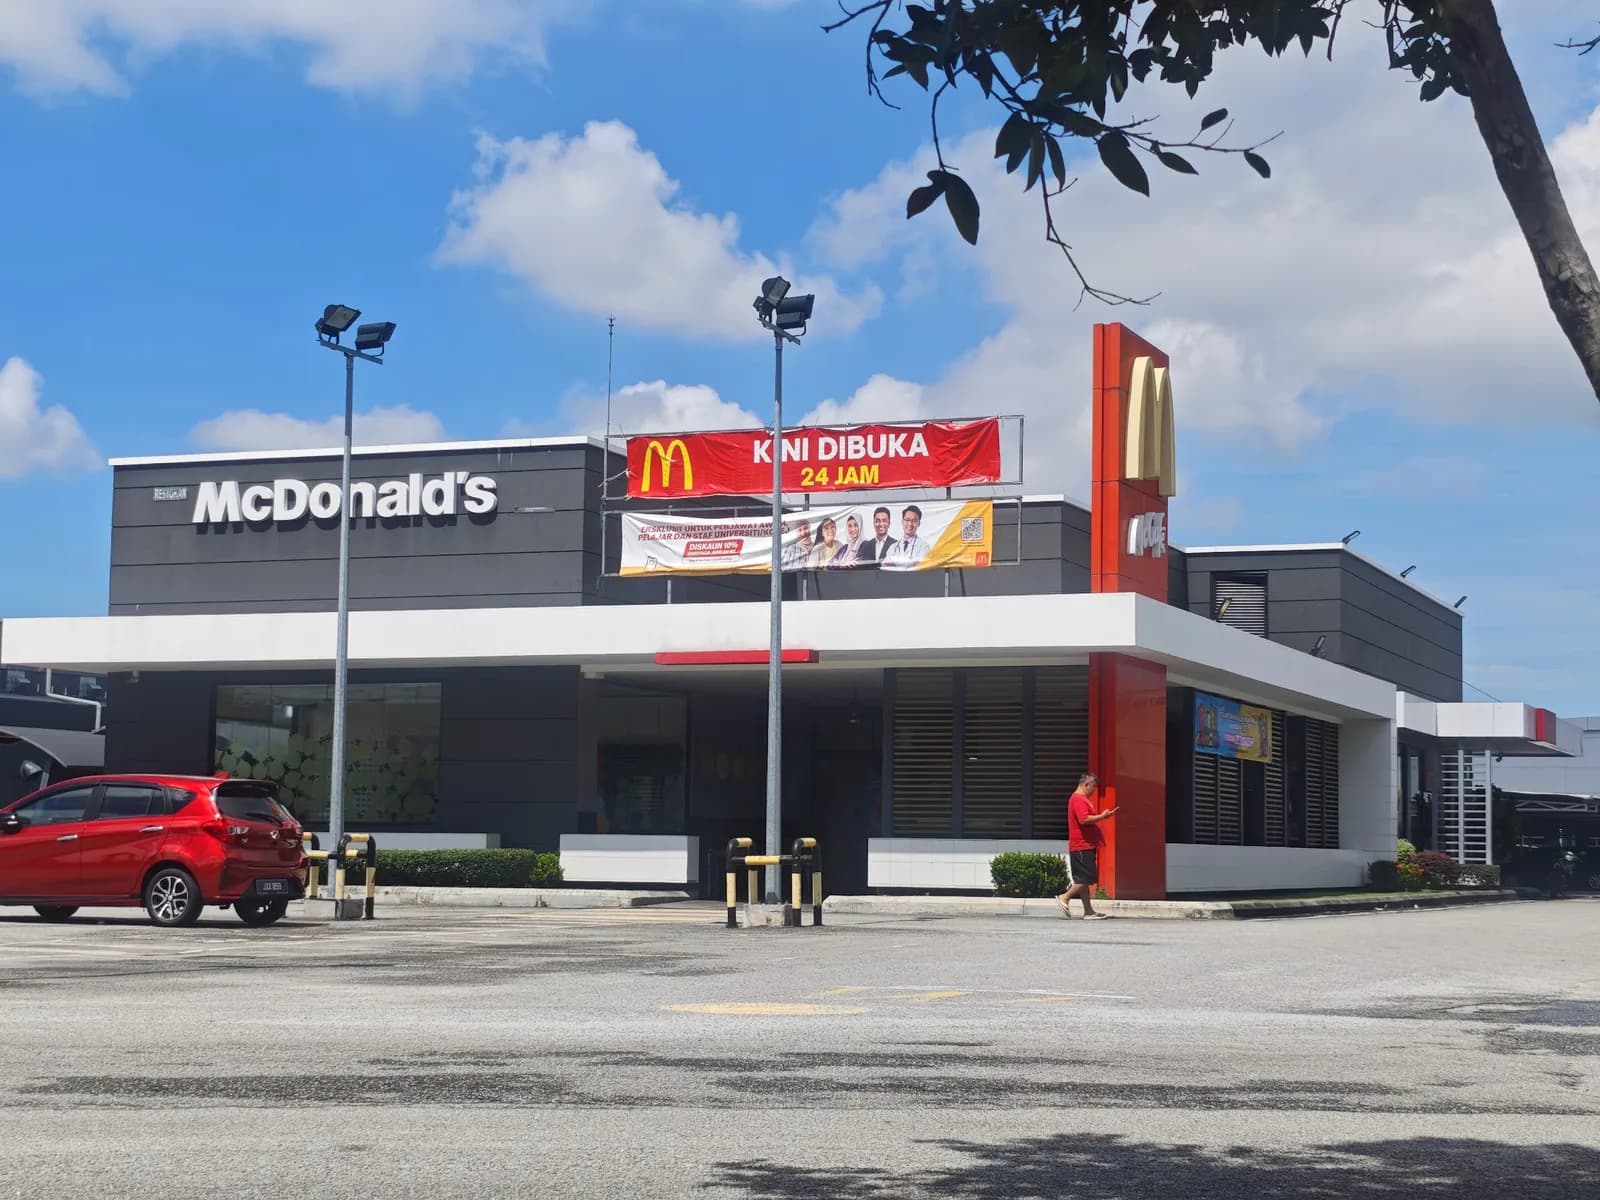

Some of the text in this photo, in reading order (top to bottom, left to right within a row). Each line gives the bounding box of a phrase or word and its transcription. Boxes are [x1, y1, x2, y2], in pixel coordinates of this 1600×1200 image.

[753, 433, 929, 464] KNI DIBUKA
[800, 464, 879, 487] 24 JAM
[191, 471, 498, 524] McDonald's
[674, 532, 692, 541] DAN
[693, 532, 712, 540] STAF
[714, 525, 790, 538] UNIVERSITI/KOEJ
[684, 524, 712, 532] UNTUK
[689, 540, 739, 551] DISKAUN 10%
